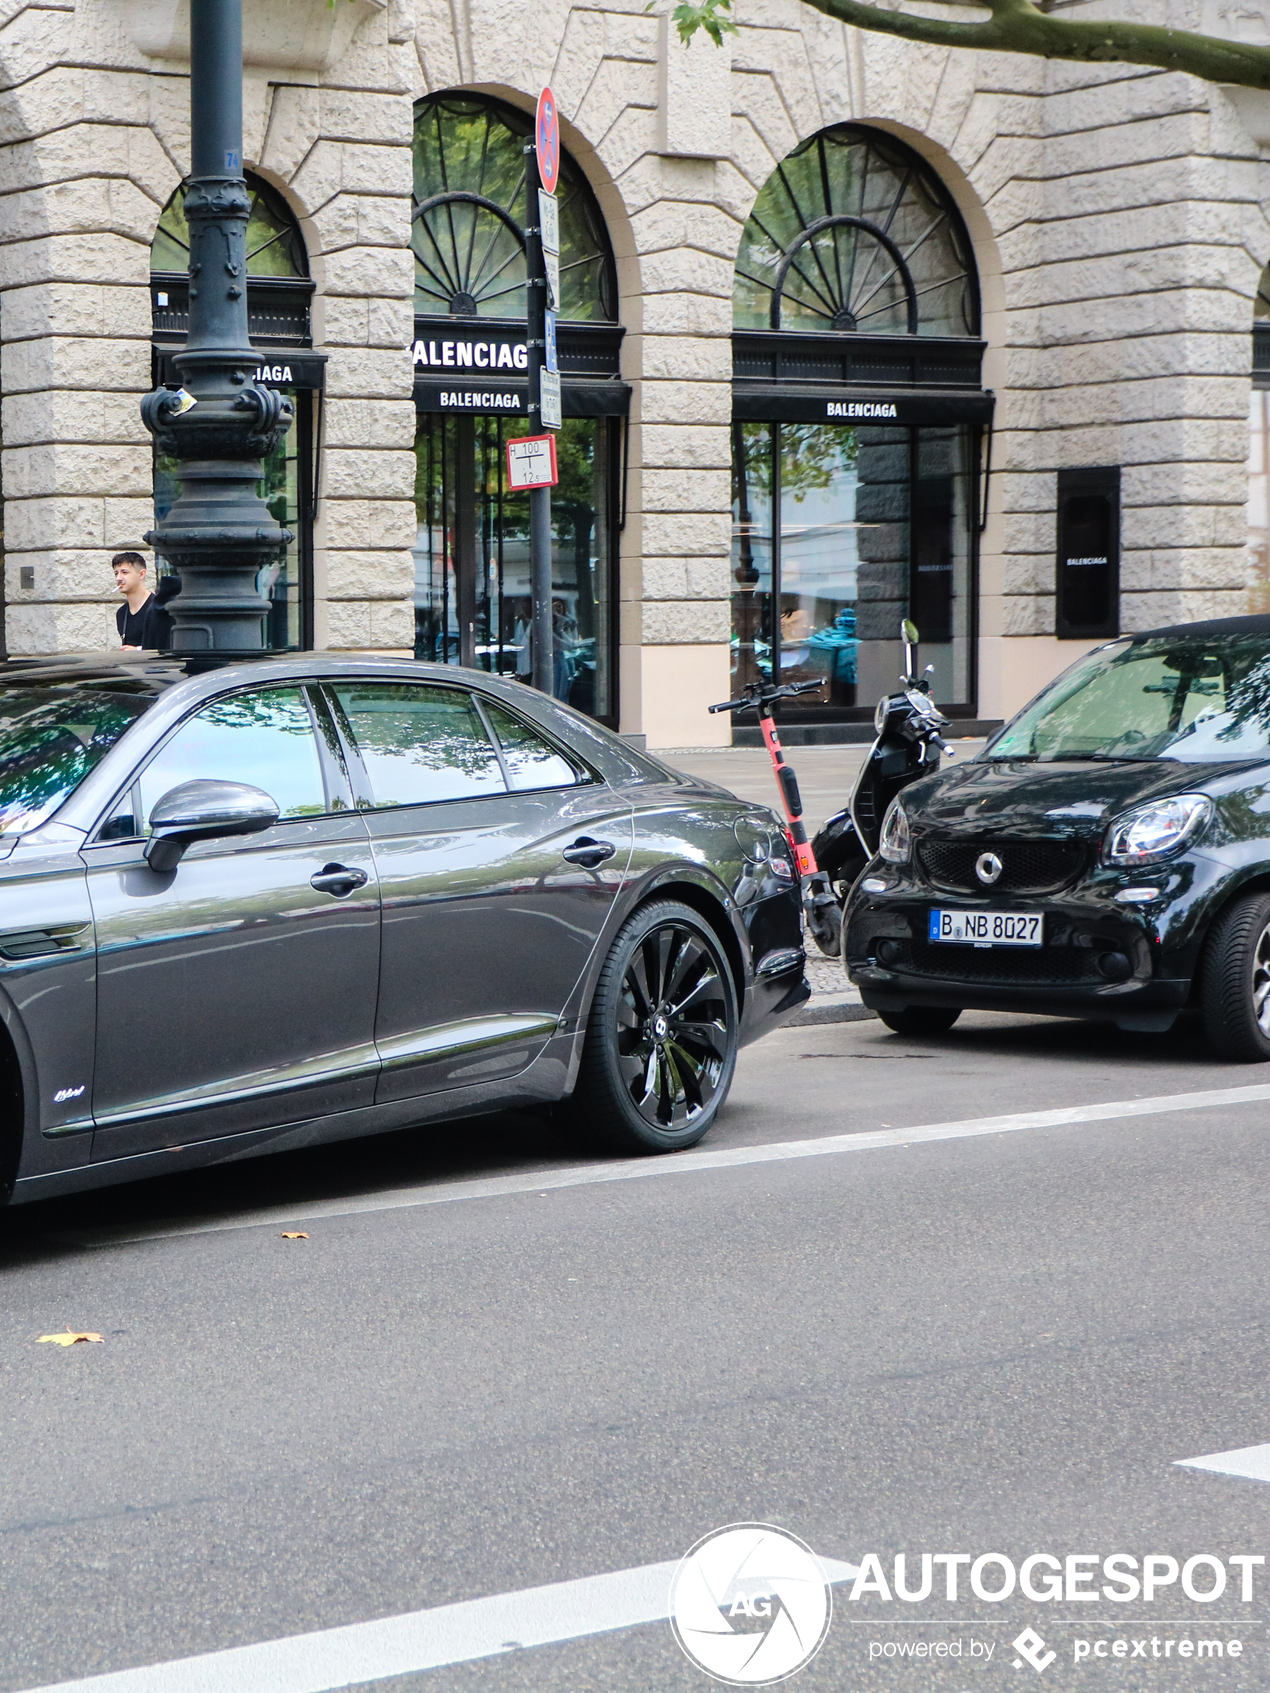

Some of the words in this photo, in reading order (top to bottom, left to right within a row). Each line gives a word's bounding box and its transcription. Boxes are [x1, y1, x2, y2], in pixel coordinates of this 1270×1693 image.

[406, 340, 528, 369] ALENCIAG
[251, 365, 293, 382] IAGA
[440, 391, 521, 408] BALENCIAGA
[826, 402, 898, 418] BALENCIAGA
[510, 445, 516, 457] H
[523, 441, 540, 455] 100
[1066, 556, 1108, 566] BALENCIAGA
[941, 914, 952, 936] B
[965, 915, 988, 938] NB
[993, 916, 1039, 940] 8027
